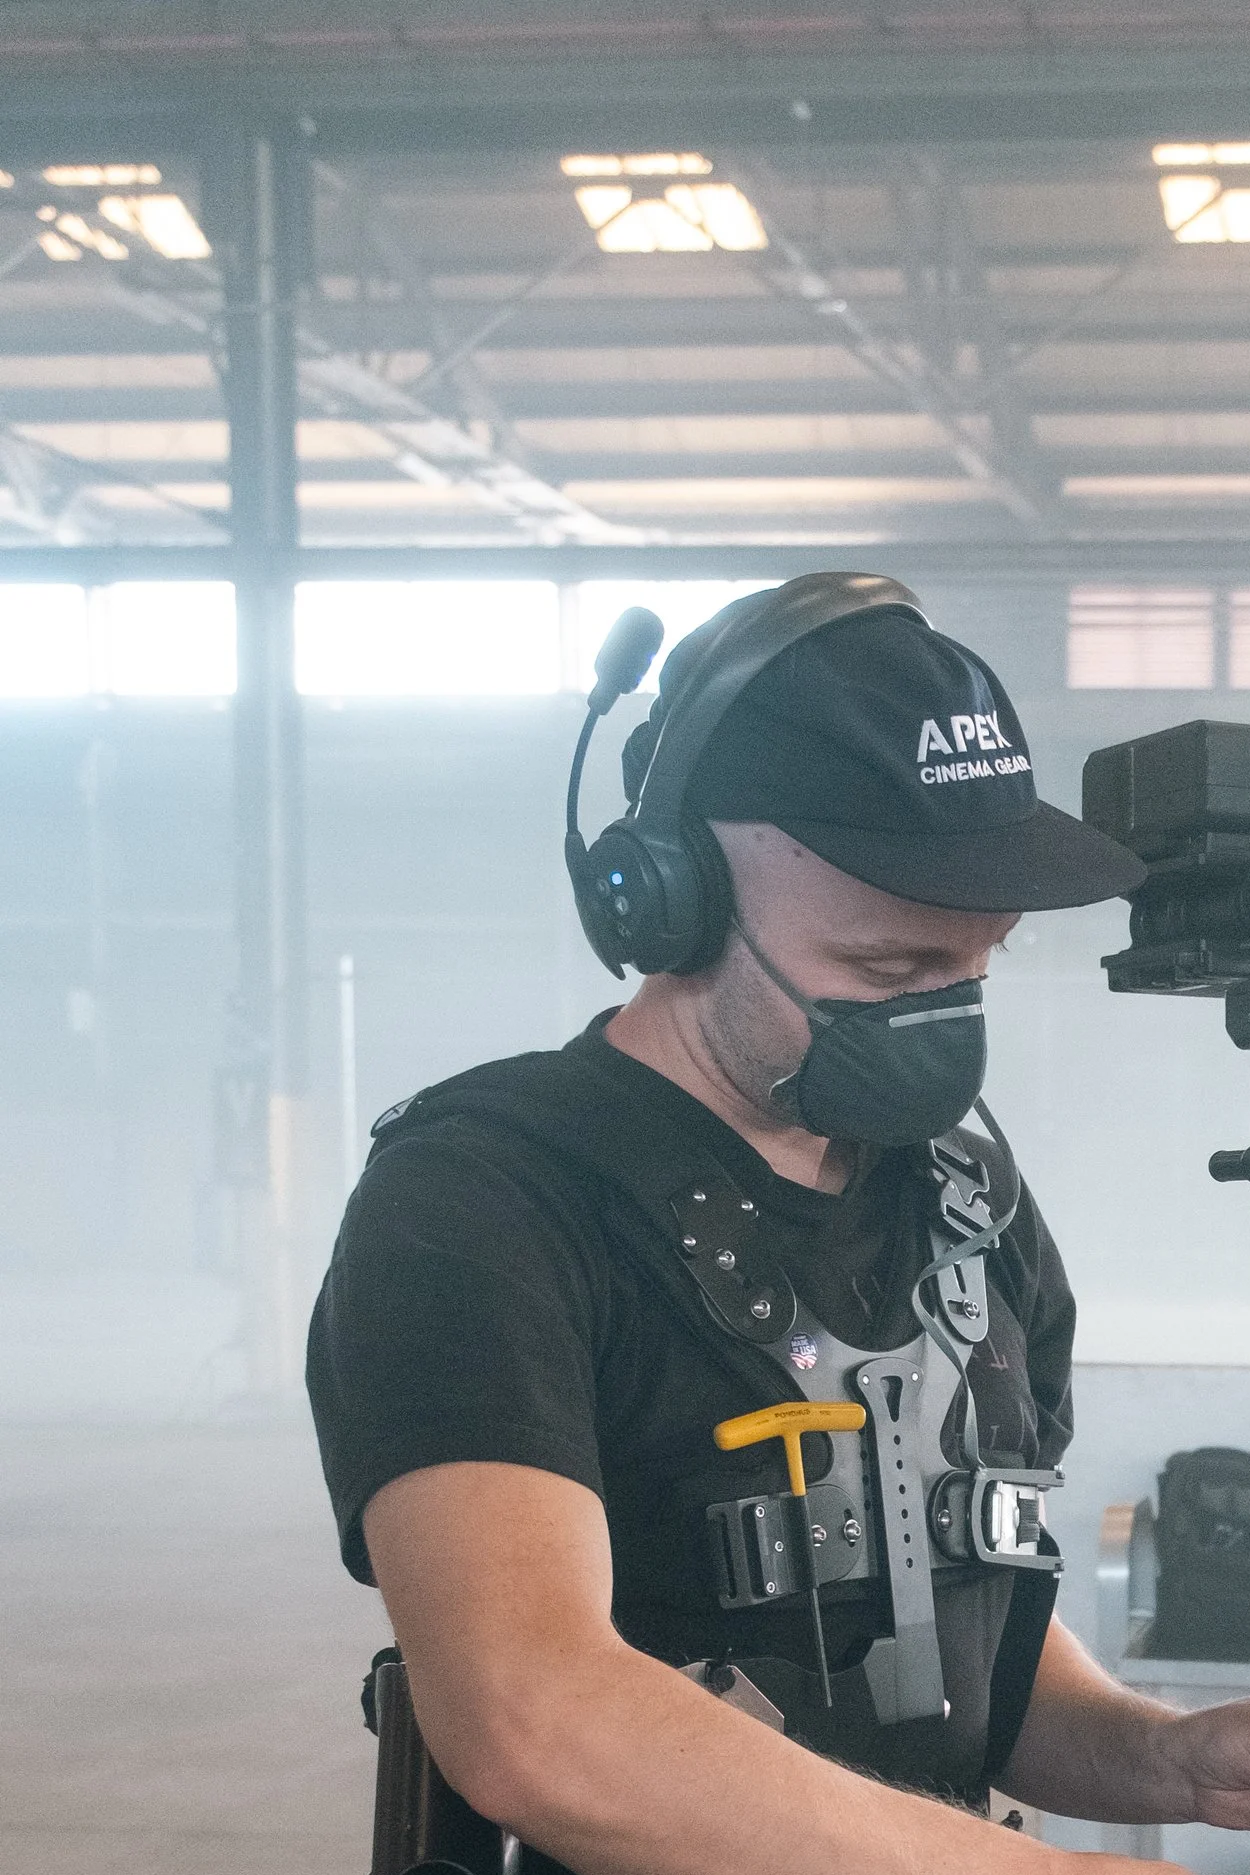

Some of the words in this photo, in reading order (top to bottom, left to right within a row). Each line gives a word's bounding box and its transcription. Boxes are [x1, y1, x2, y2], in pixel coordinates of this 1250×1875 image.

[917, 710, 1012, 762] APEX
[920, 760, 995, 784] CINEMA
[994, 755, 1032, 775] GEAR
[799, 1344, 817, 1356] USA
